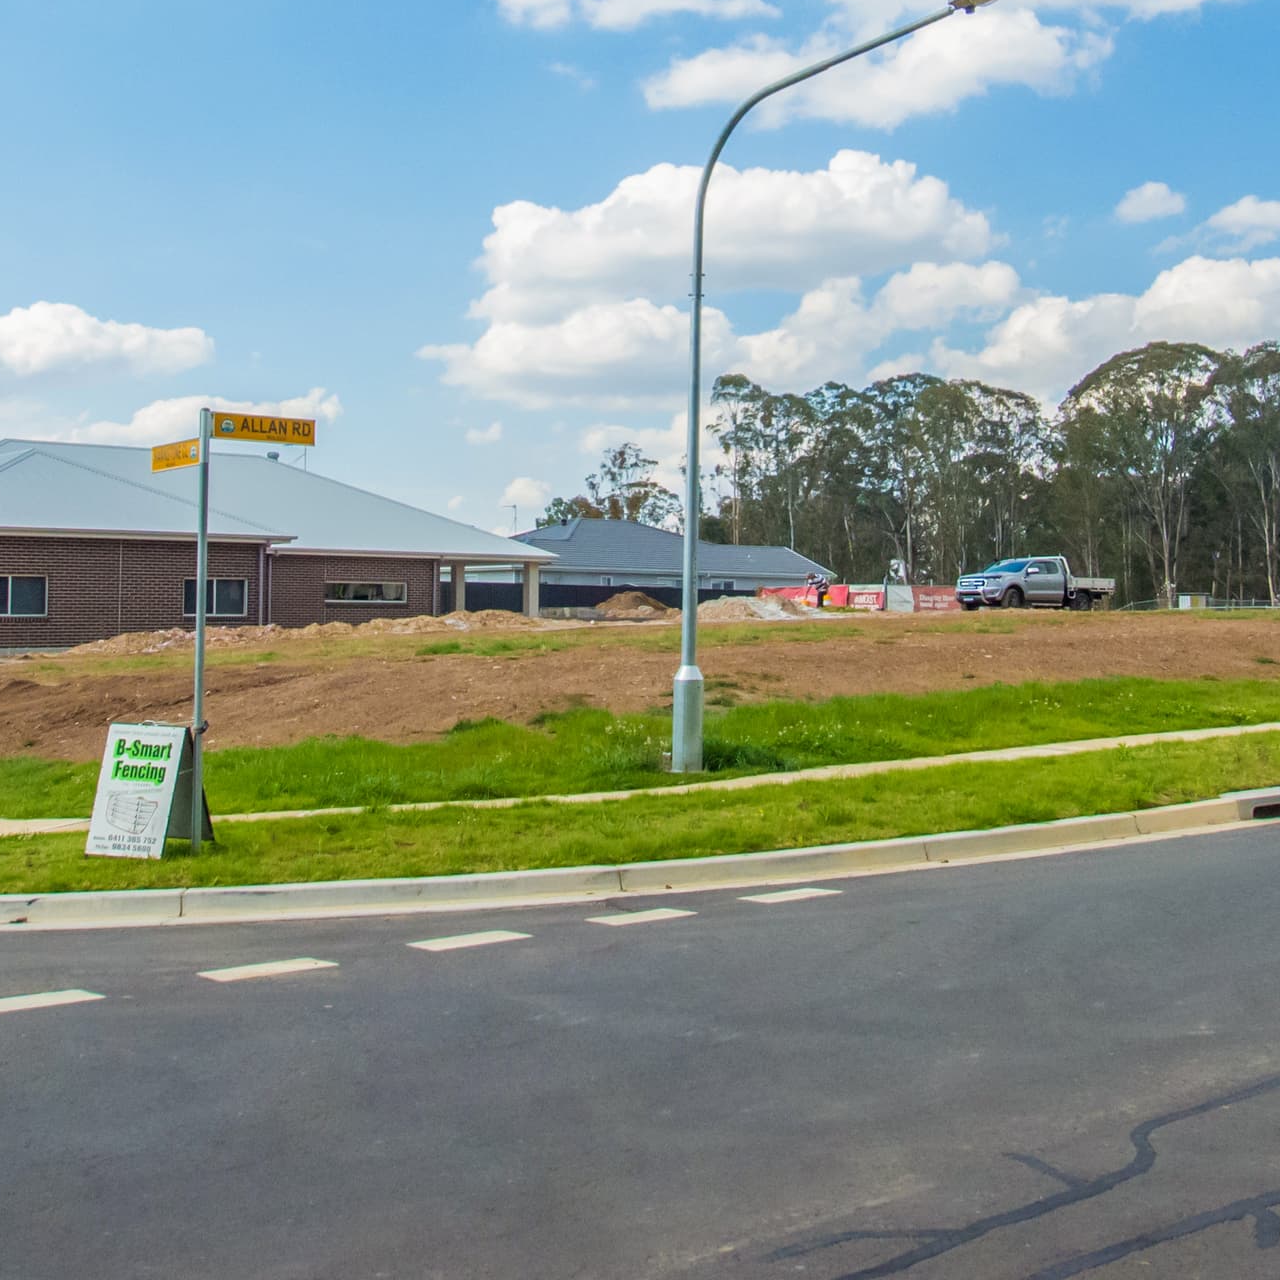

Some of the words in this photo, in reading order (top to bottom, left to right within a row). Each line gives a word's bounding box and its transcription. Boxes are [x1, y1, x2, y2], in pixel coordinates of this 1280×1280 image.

[240, 417, 287, 436] ALLAN
[292, 421, 311, 437] RD
[115, 738, 173, 759] B-Smart
[113, 760, 167, 783] Fencing
